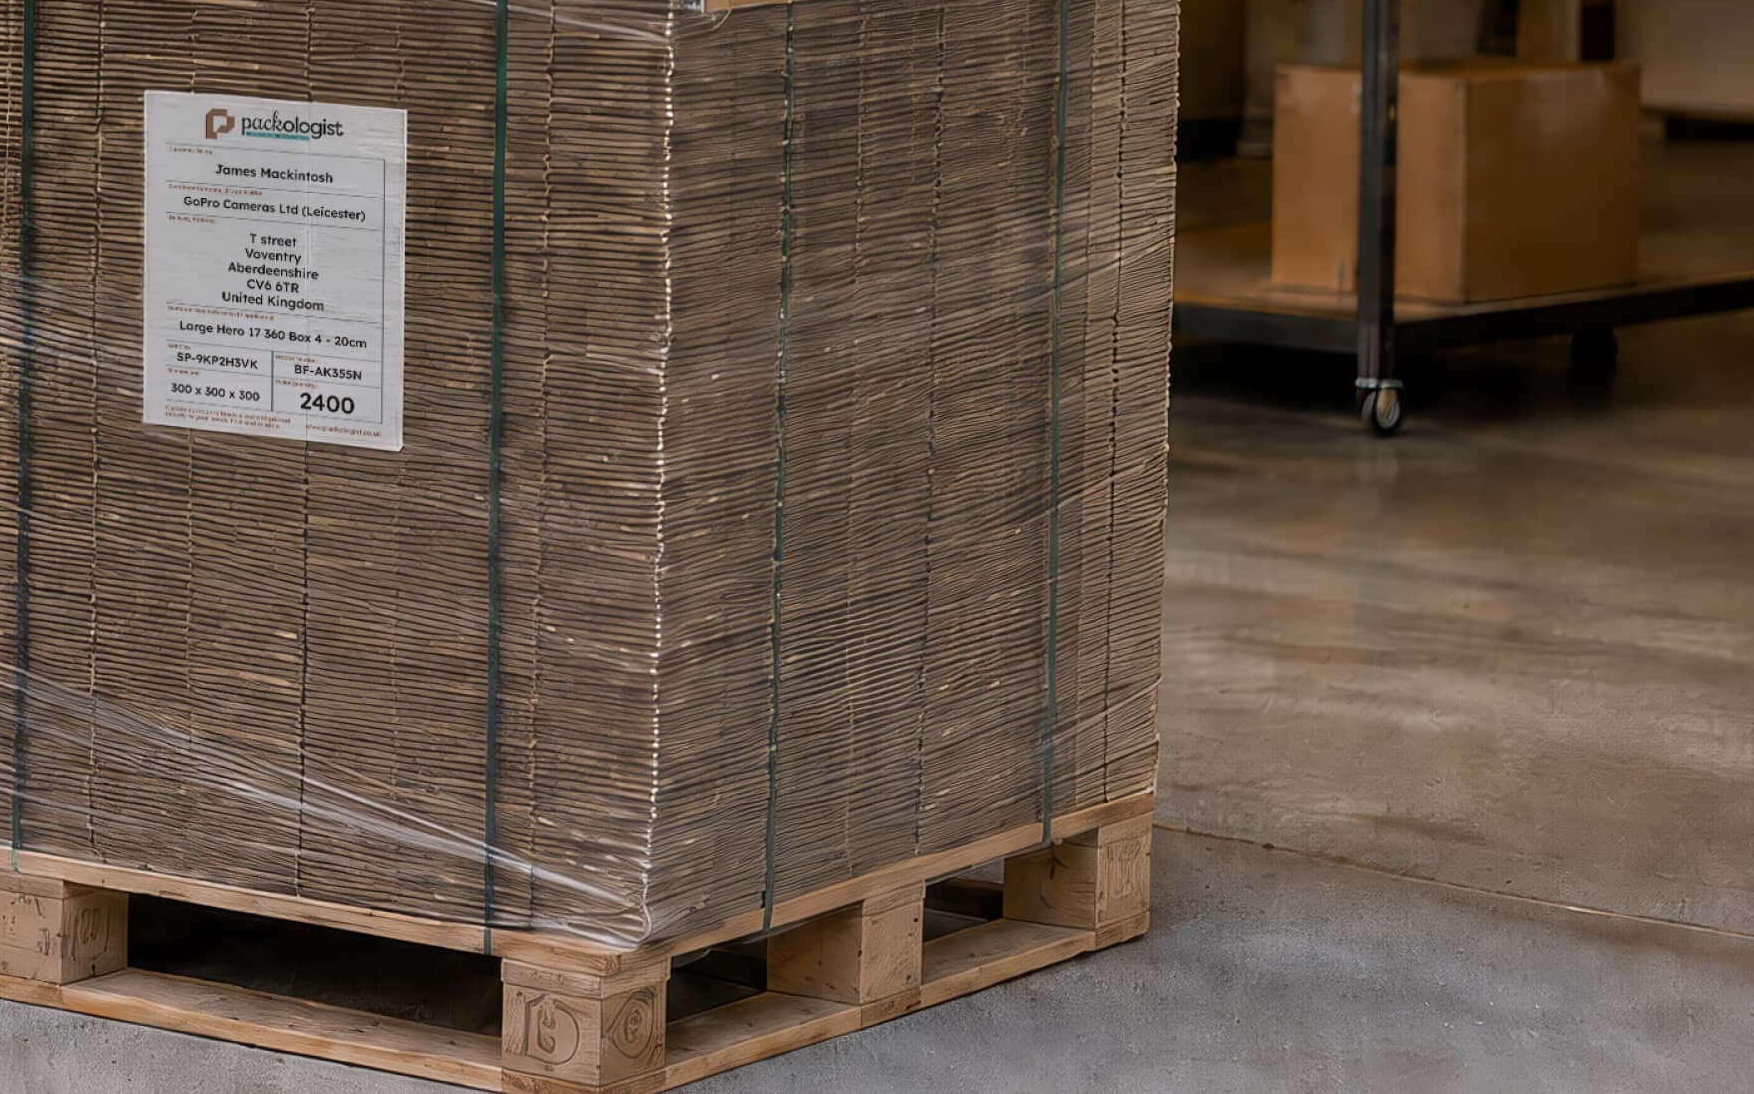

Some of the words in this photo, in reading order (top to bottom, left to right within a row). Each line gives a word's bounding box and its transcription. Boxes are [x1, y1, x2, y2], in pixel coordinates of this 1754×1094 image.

[242, 110, 344, 139] packologist
[215, 165, 257, 178] James
[260, 168, 334, 184] Mackintosh
[183, 197, 221, 209] GoPro
[222, 200, 276, 213] Cameras
[279, 204, 299, 215] Ltd
[301, 207, 366, 222] (Leicester)
[249, 233, 257, 244] T
[260, 236, 297, 248] street
[245, 248, 301, 264] Voventry
[228, 262, 320, 280] Aberdeenshire
[246, 279, 272, 291] CV6
[275, 282, 300, 294] 6TR
[221, 292, 263, 306] United
[267, 296, 325, 312] Kingdom
[179, 321, 214, 335] Large
[216, 325, 245, 337] Hero
[249, 328, 261, 338] 17
[263, 329, 286, 341] 360
[288, 332, 311, 343] Box
[314, 335, 322, 344] 4
[334, 336, 367, 349] 20cm
[171, 383, 193, 395] 300
[195, 387, 202, 395] x
[204, 387, 226, 398] 300
[229, 391, 236, 400] x
[238, 391, 261, 402] 300
[300, 393, 355, 415] 2400
